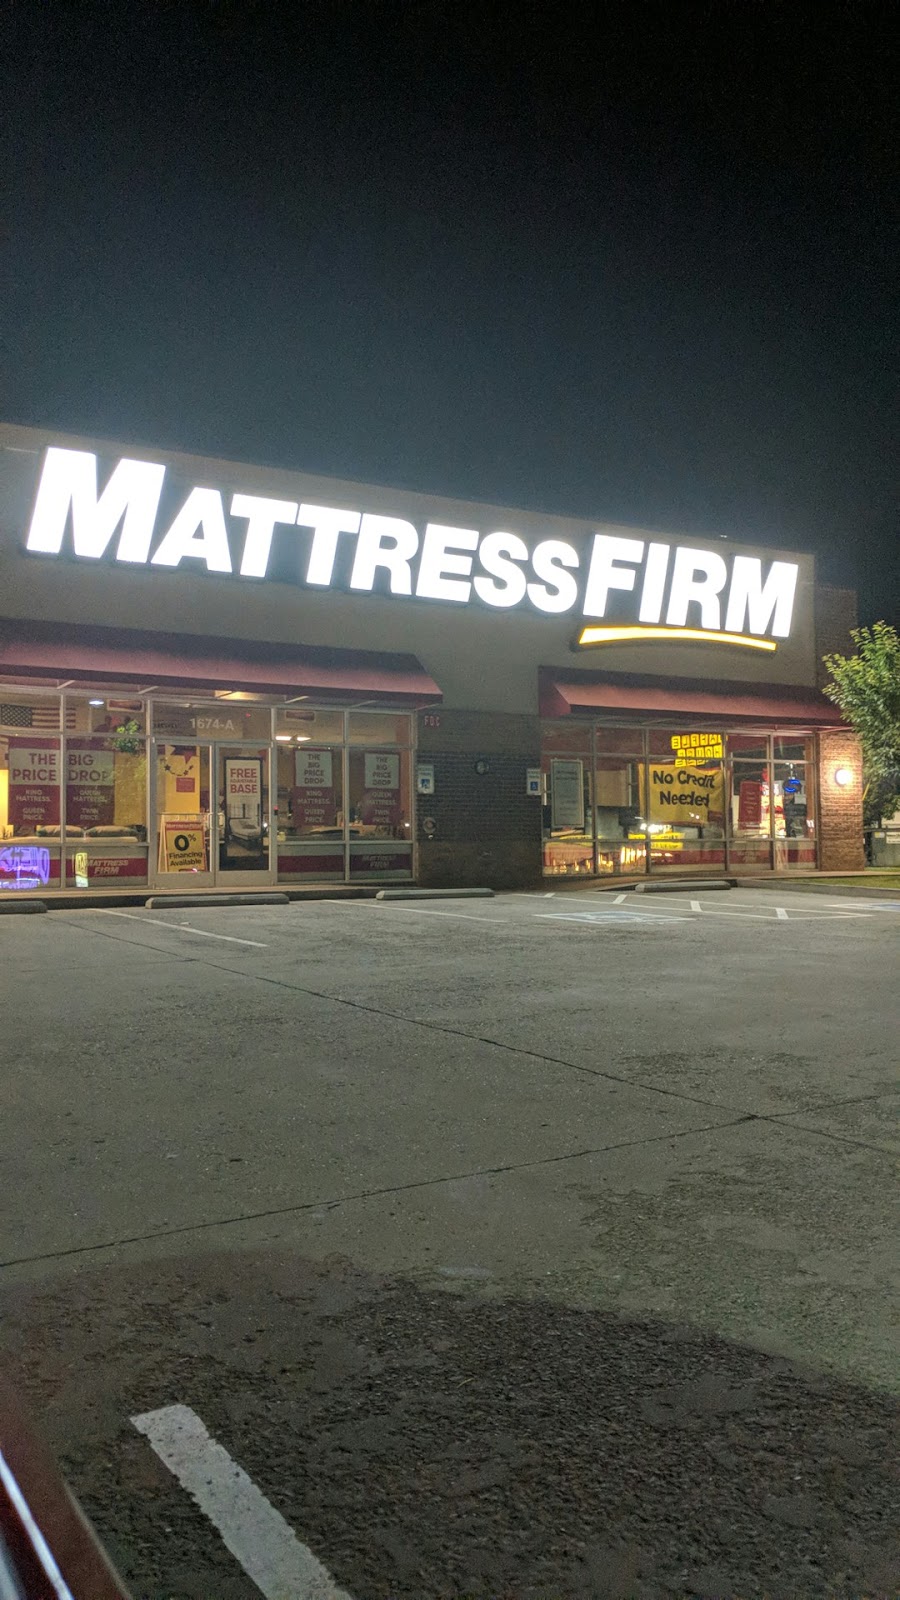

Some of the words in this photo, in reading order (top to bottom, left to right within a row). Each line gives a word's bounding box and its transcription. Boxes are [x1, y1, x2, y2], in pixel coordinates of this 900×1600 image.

[189, 718, 235, 731] 1674-A
[28, 753, 57, 766] THE
[68, 754, 94, 766] BIG
[11, 769, 57, 781] PRICE
[68, 770, 109, 781] DROP
[229, 768, 258, 779] FREE
[303, 769, 324, 777] PRICE
[372, 771, 392, 779] PRICE
[653, 771, 674, 784] No
[678, 771, 715, 788] Credit
[229, 784, 258, 794] BASE
[660, 791, 710, 807] Needed
[168, 851, 203, 860] Financing
[85, 859, 129, 867] MATTRESS
[169, 858, 202, 867] Available
[93, 866, 120, 875] FIRM
